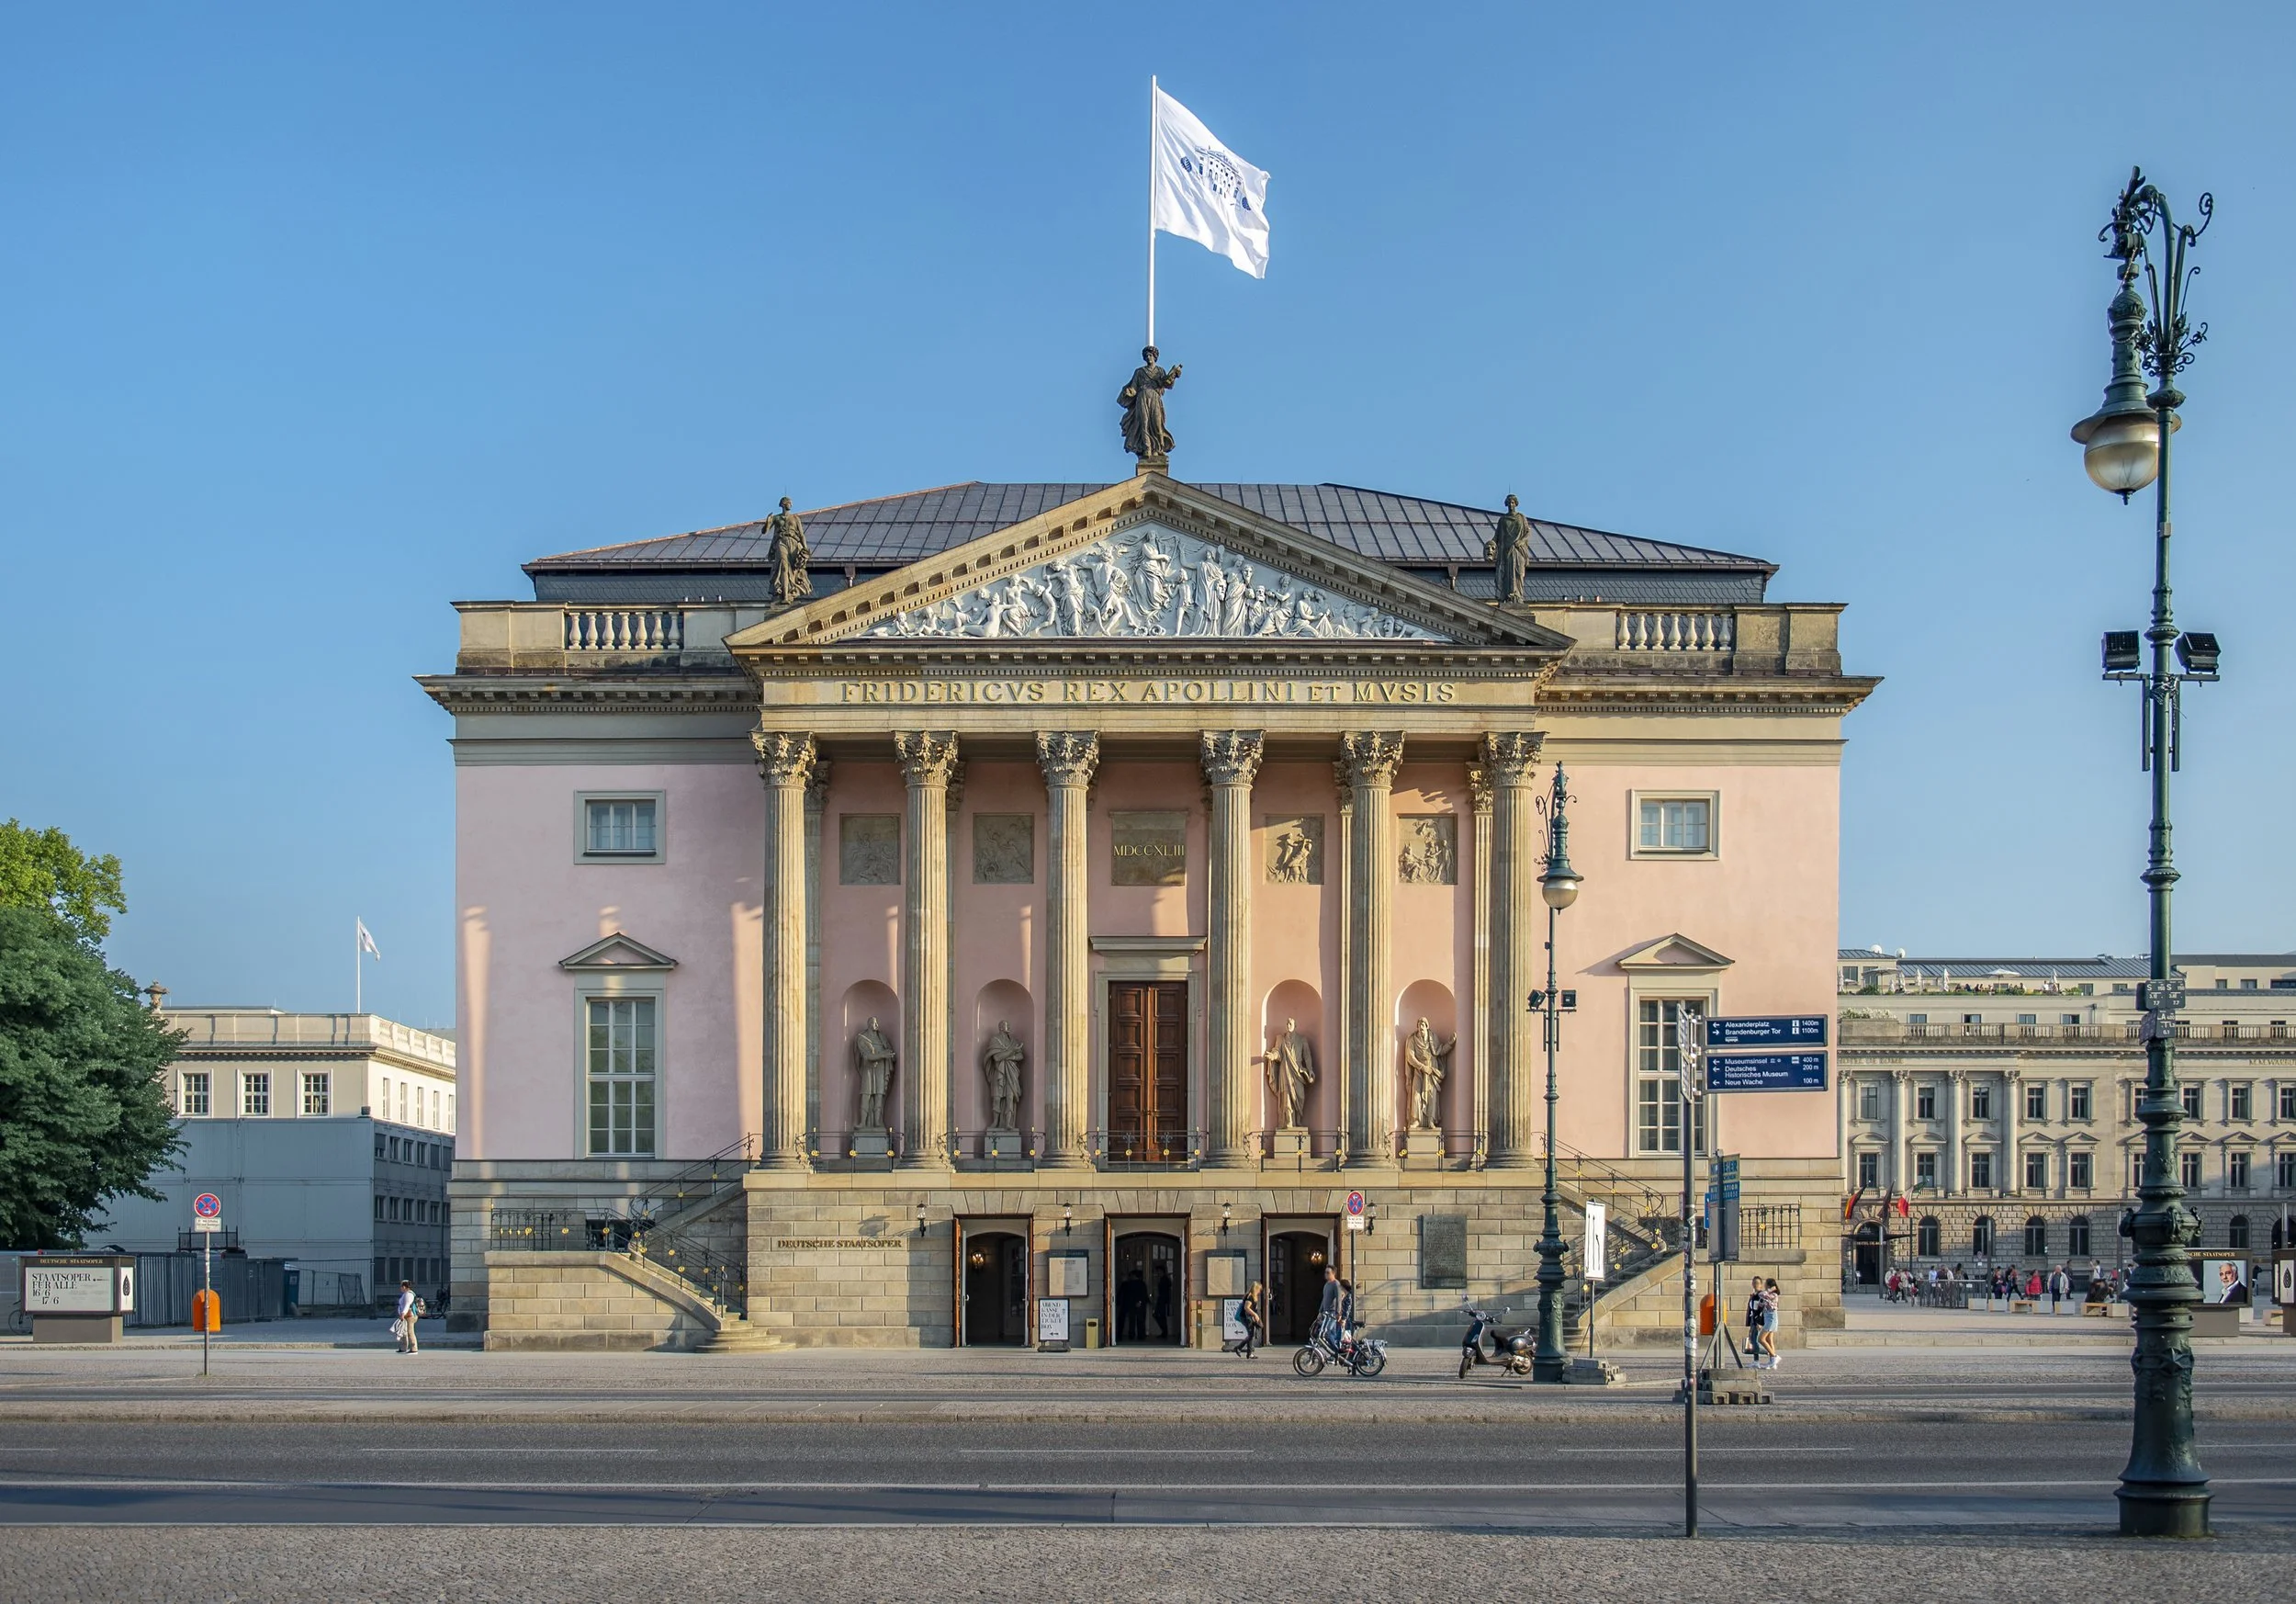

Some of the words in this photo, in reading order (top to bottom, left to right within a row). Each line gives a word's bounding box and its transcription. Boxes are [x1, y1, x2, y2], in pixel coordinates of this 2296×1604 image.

[840, 683, 1044, 703] FRIDERICVS
[1063, 683, 1129, 703] REX
[1140, 682, 1297, 702] APOLLINI
[1307, 686, 1341, 702] ET
[1352, 682, 1455, 703] MVSIS
[1113, 844, 1185, 856] MDCCXLIII
[777, 1239, 835, 1248] DEUTSCHE
[837, 1239, 902, 1248] STAATSOPER
[32, 1273, 91, 1282] STAATSOPER
